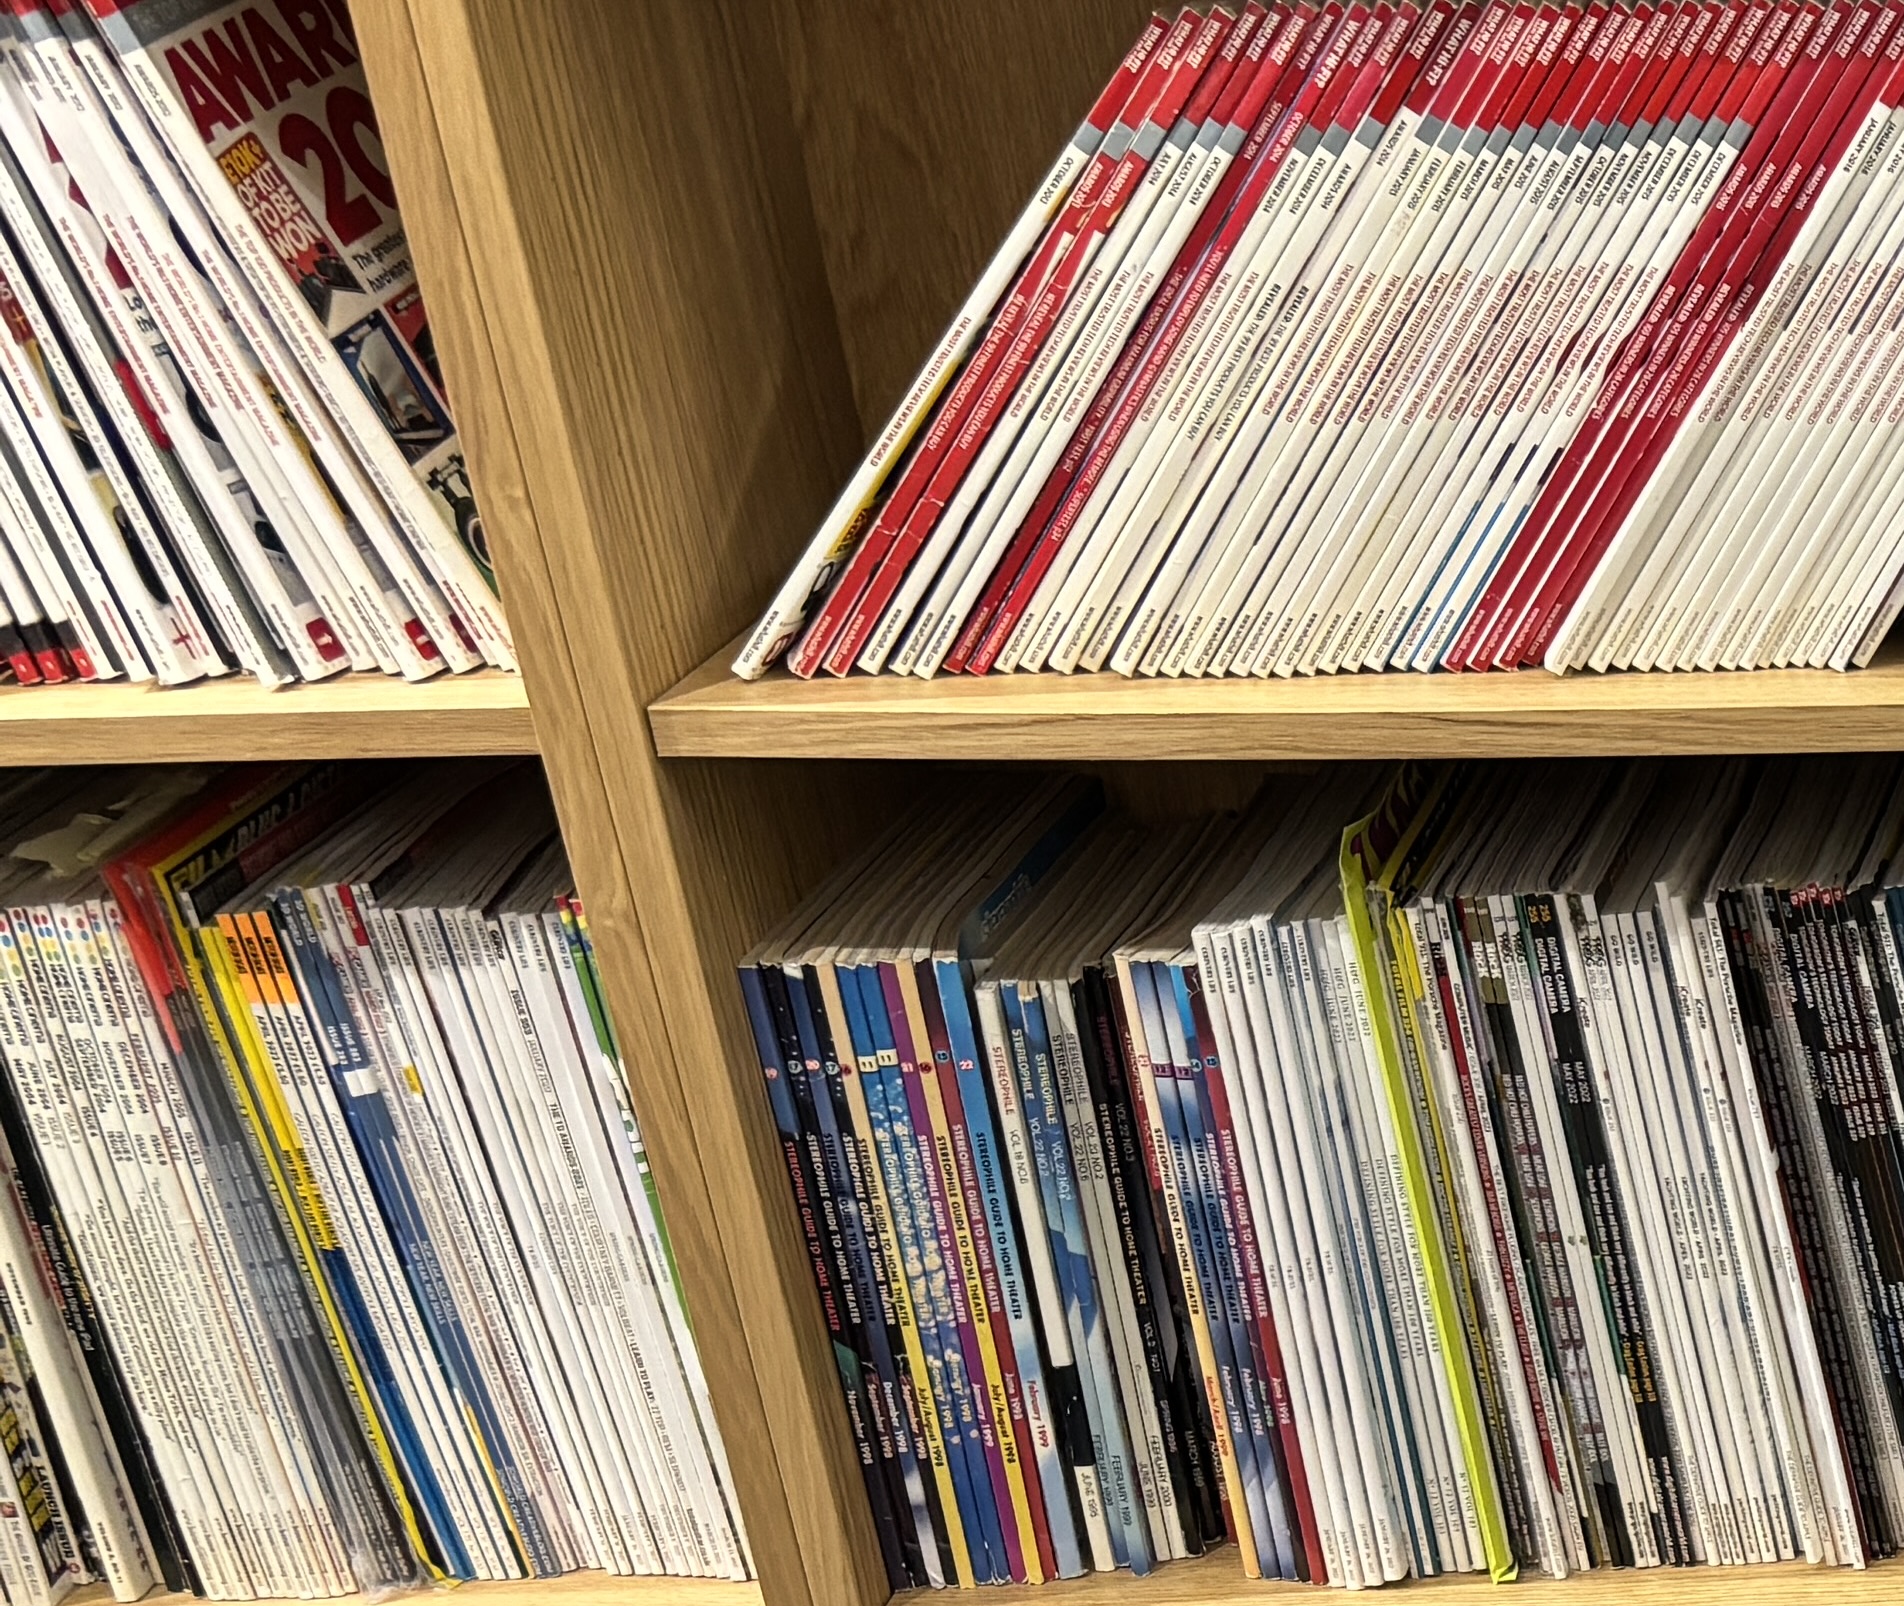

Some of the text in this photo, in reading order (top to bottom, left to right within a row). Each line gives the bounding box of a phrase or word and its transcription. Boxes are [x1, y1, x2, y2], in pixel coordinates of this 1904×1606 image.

[164, 0, 358, 144] AWAR
[237, 176, 257, 208] OF
[269, 211, 322, 260] WON
[1546, 935, 1571, 1012] DIGITAL CAMERA
[1052, 1034, 1075, 1105] STEREOPHILE
[917, 1133, 967, 1323] STEREOPHILE GUIDE TO HOME THEATER
[976, 1131, 1022, 1320] STEREOPHILE GUIDE TO HOME THEATER
